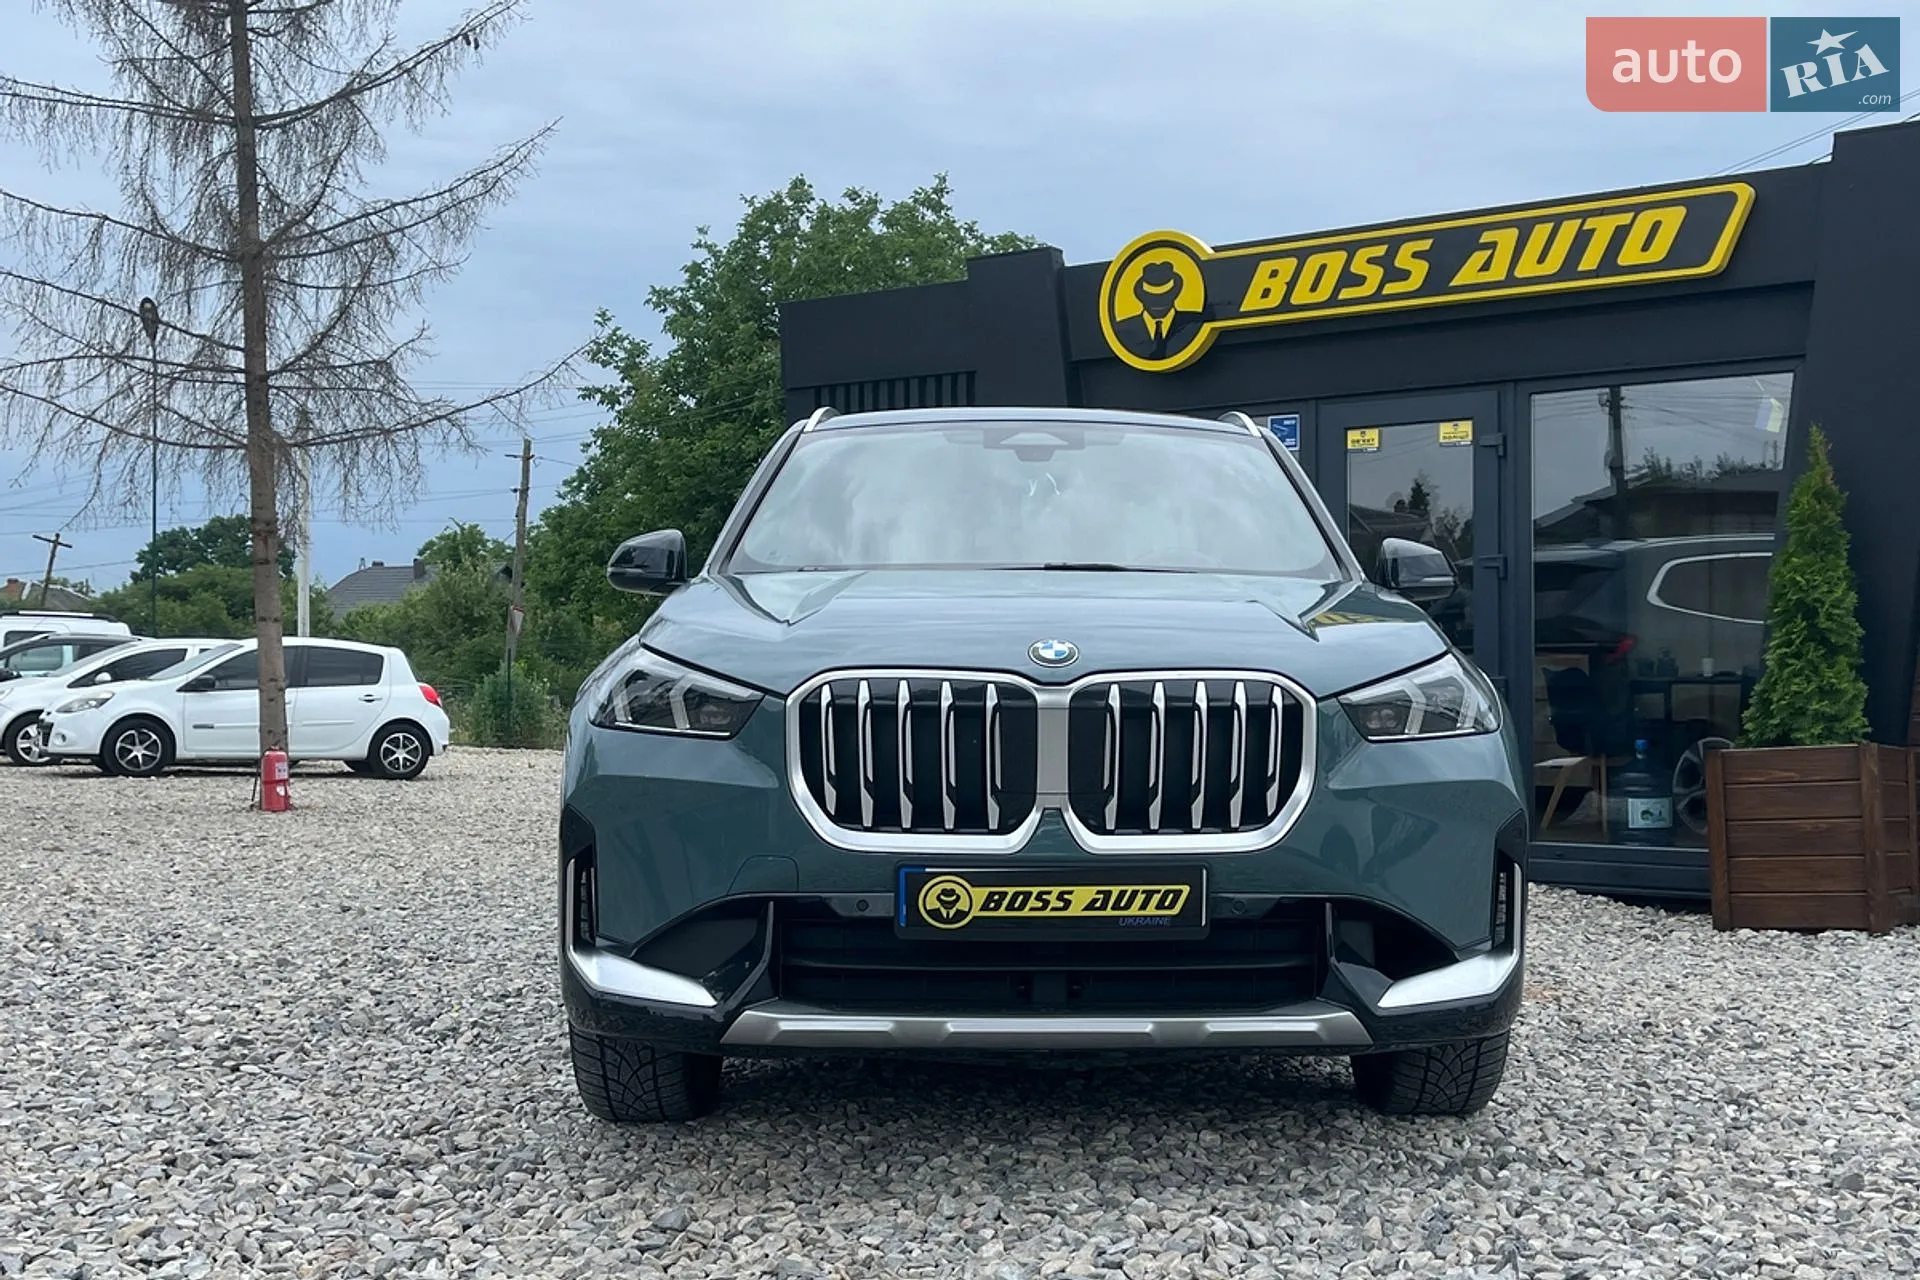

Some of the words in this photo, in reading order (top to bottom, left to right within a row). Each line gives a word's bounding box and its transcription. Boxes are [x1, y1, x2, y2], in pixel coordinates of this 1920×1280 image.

[1240, 238, 1433, 313] BOSS
[1449, 205, 1688, 287] AUTO
[979, 889, 1074, 912] BOSS
[1081, 888, 1184, 912] AUTO
[1119, 916, 1172, 926] UKRAINE
